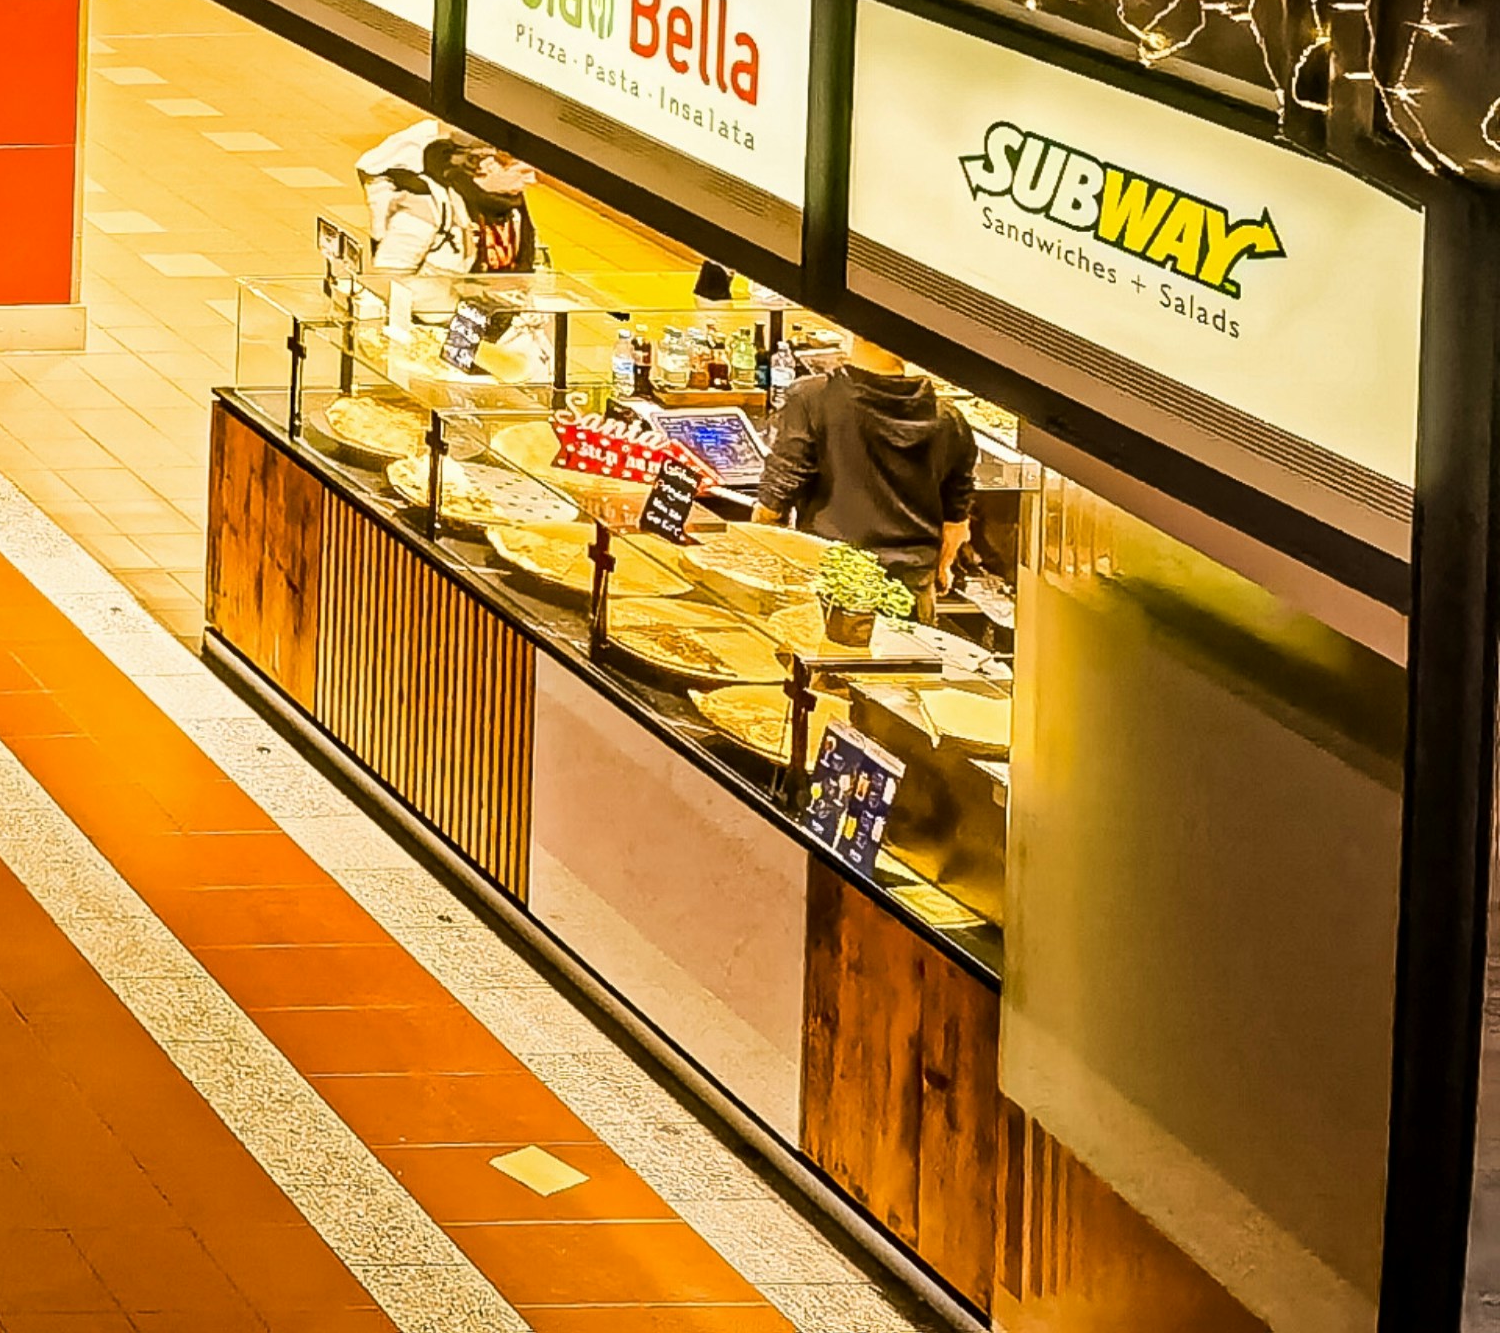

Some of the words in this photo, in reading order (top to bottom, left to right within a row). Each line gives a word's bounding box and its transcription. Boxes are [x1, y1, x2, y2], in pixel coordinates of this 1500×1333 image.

[516, 23, 567, 65] Pizza
[585, 53, 640, 99] Pasta
[660, 86, 756, 152] Insalata
[959, 120, 1287, 300] SUBWAY
[981, 205, 1118, 285] Sandwiches
[1158, 282, 1241, 340] Salads
